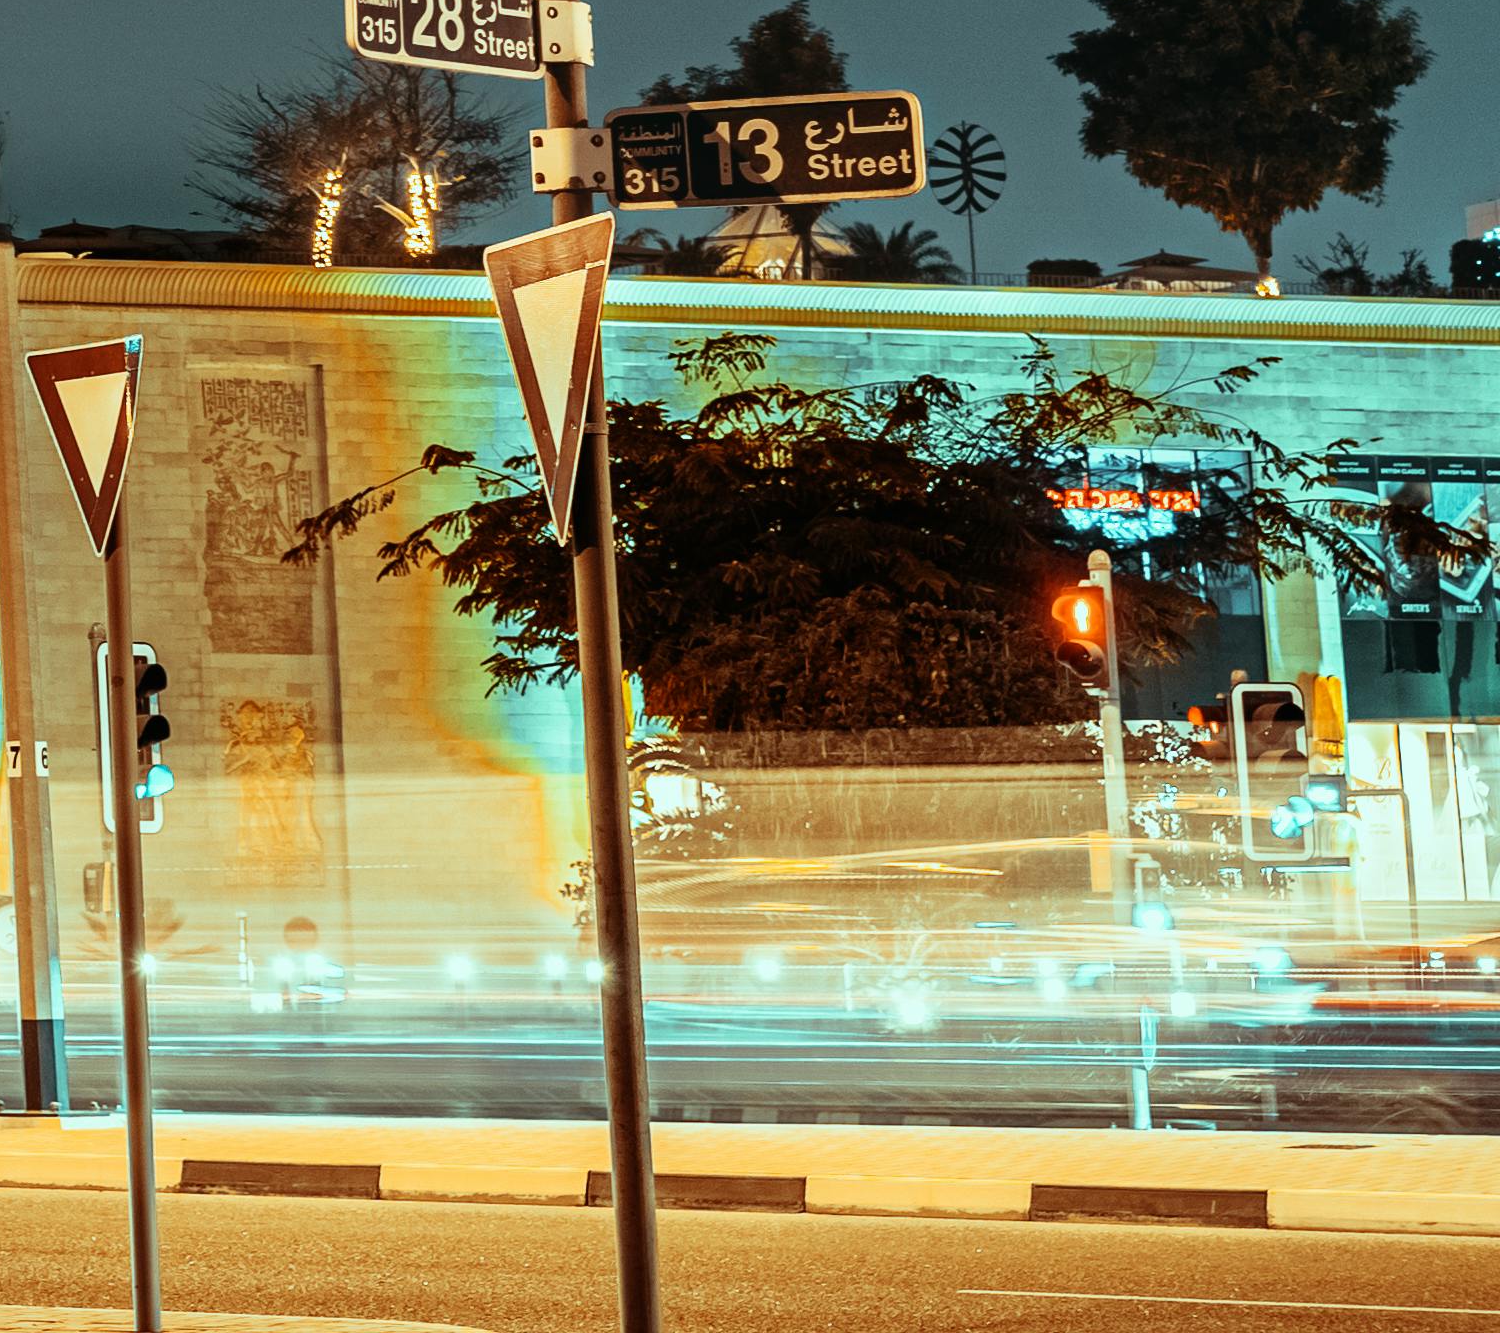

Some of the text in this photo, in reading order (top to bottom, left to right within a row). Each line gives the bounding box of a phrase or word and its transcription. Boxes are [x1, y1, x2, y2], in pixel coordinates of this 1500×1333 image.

[361, 15, 397, 45] 315
[473, 28, 536, 61] Street
[619, 122, 680, 142] المنطقة
[804, 107, 908, 150] شارع
[620, 144, 682, 160] COMMUNITY
[703, 118, 784, 185] 13
[807, 148, 912, 180] Street
[625, 167, 680, 195] 315
[10, 746, 20, 769] 7
